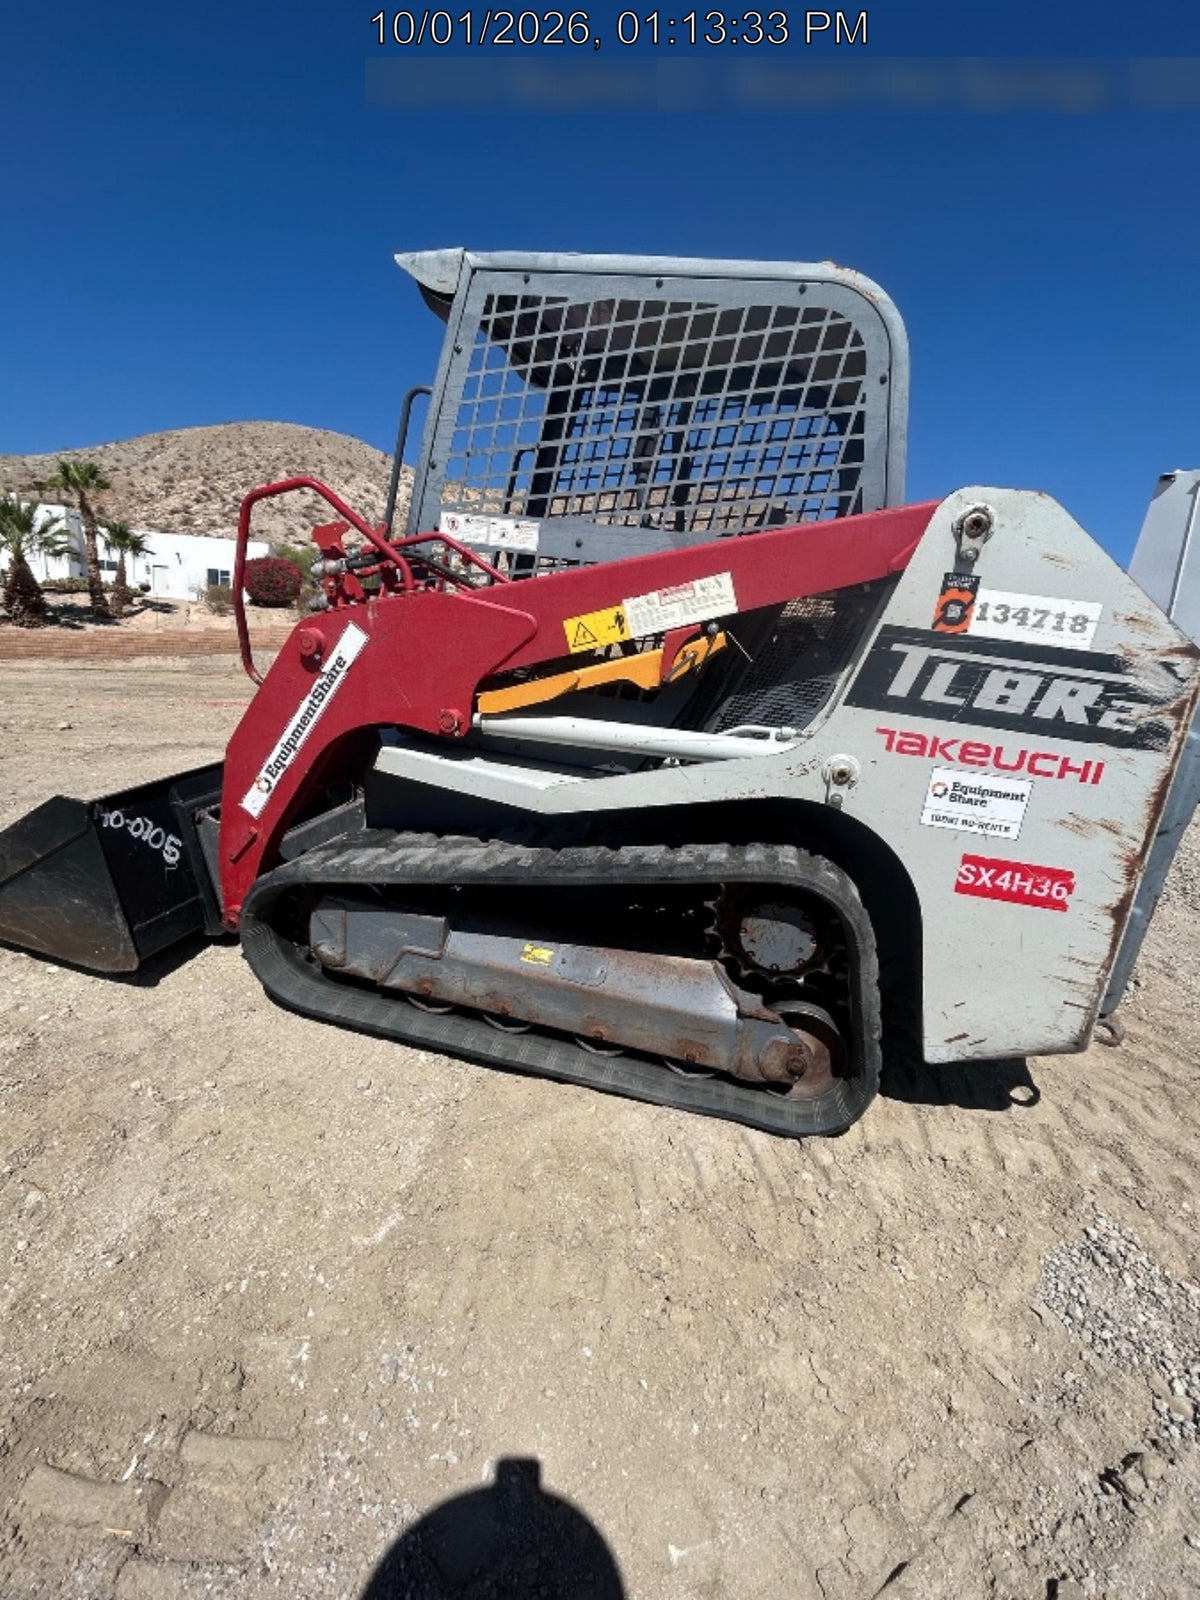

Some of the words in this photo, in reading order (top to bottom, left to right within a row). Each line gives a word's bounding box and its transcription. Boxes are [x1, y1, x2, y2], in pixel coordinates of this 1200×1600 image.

[975, 602, 1090, 633] 134718
[264, 653, 348, 781] EquipmentShare
[949, 792, 988, 808] Share
[951, 781, 1026, 802] Equipment
[958, 863, 1068, 900] SX4H36
